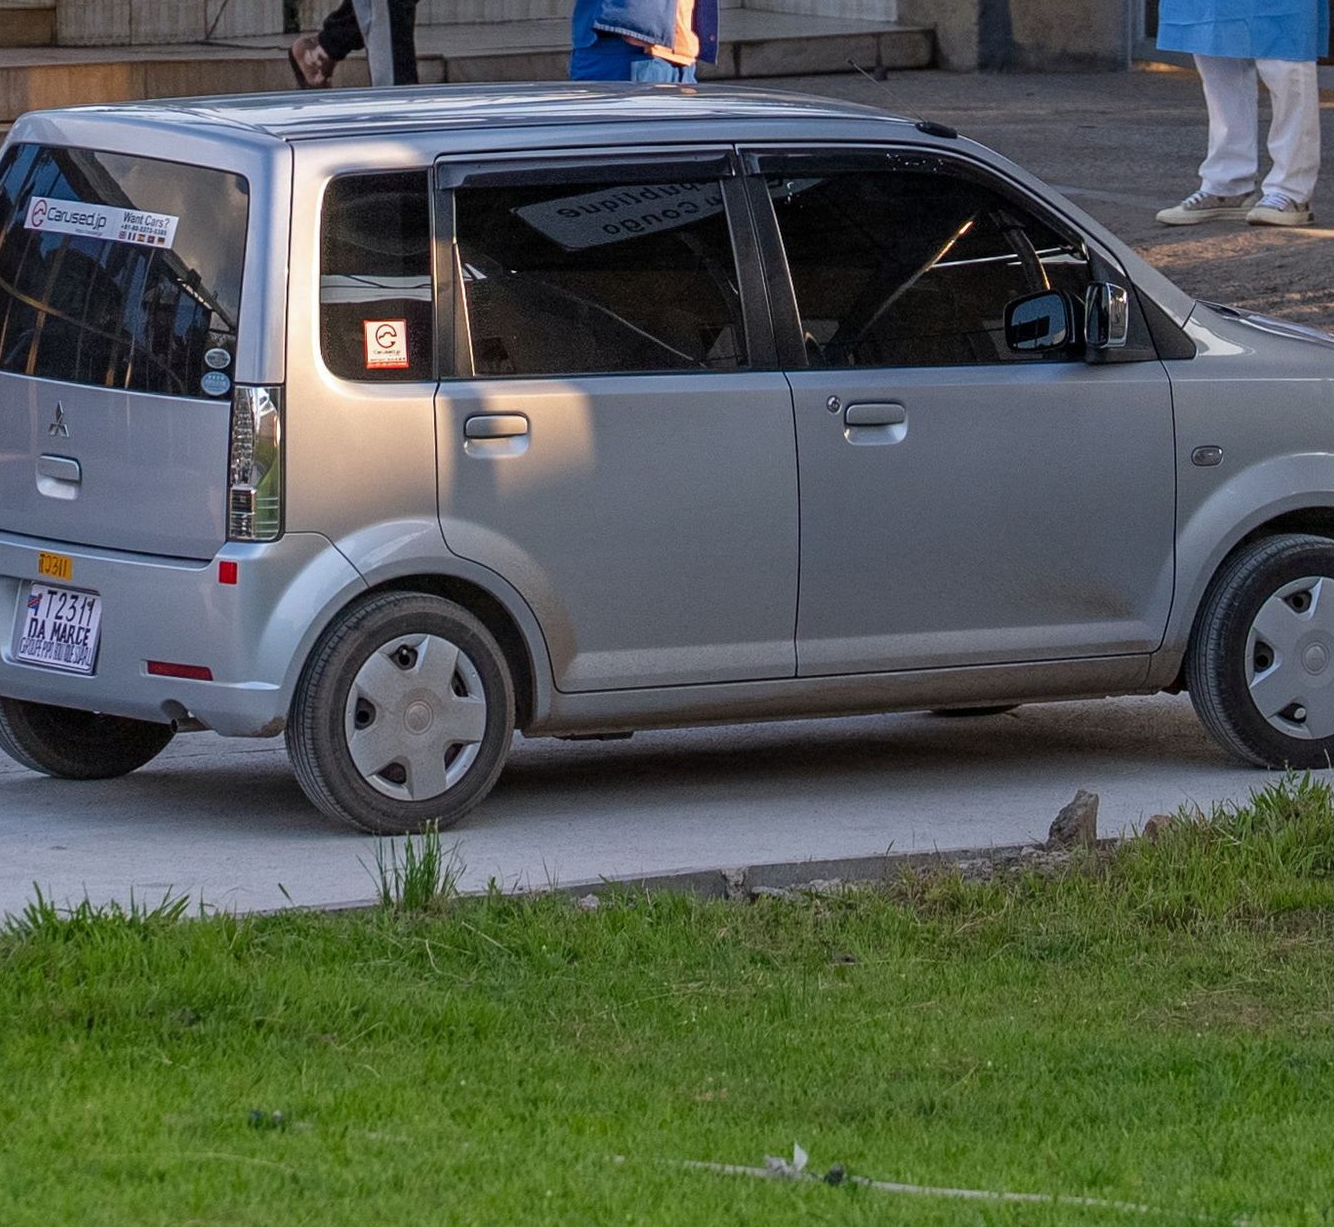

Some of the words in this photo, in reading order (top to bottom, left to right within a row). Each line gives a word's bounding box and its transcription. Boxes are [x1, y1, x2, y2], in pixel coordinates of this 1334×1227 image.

[47, 207, 107, 229] Carused.jp
[123, 211, 143, 225] Want
[144, 214, 171, 229] Cars?
